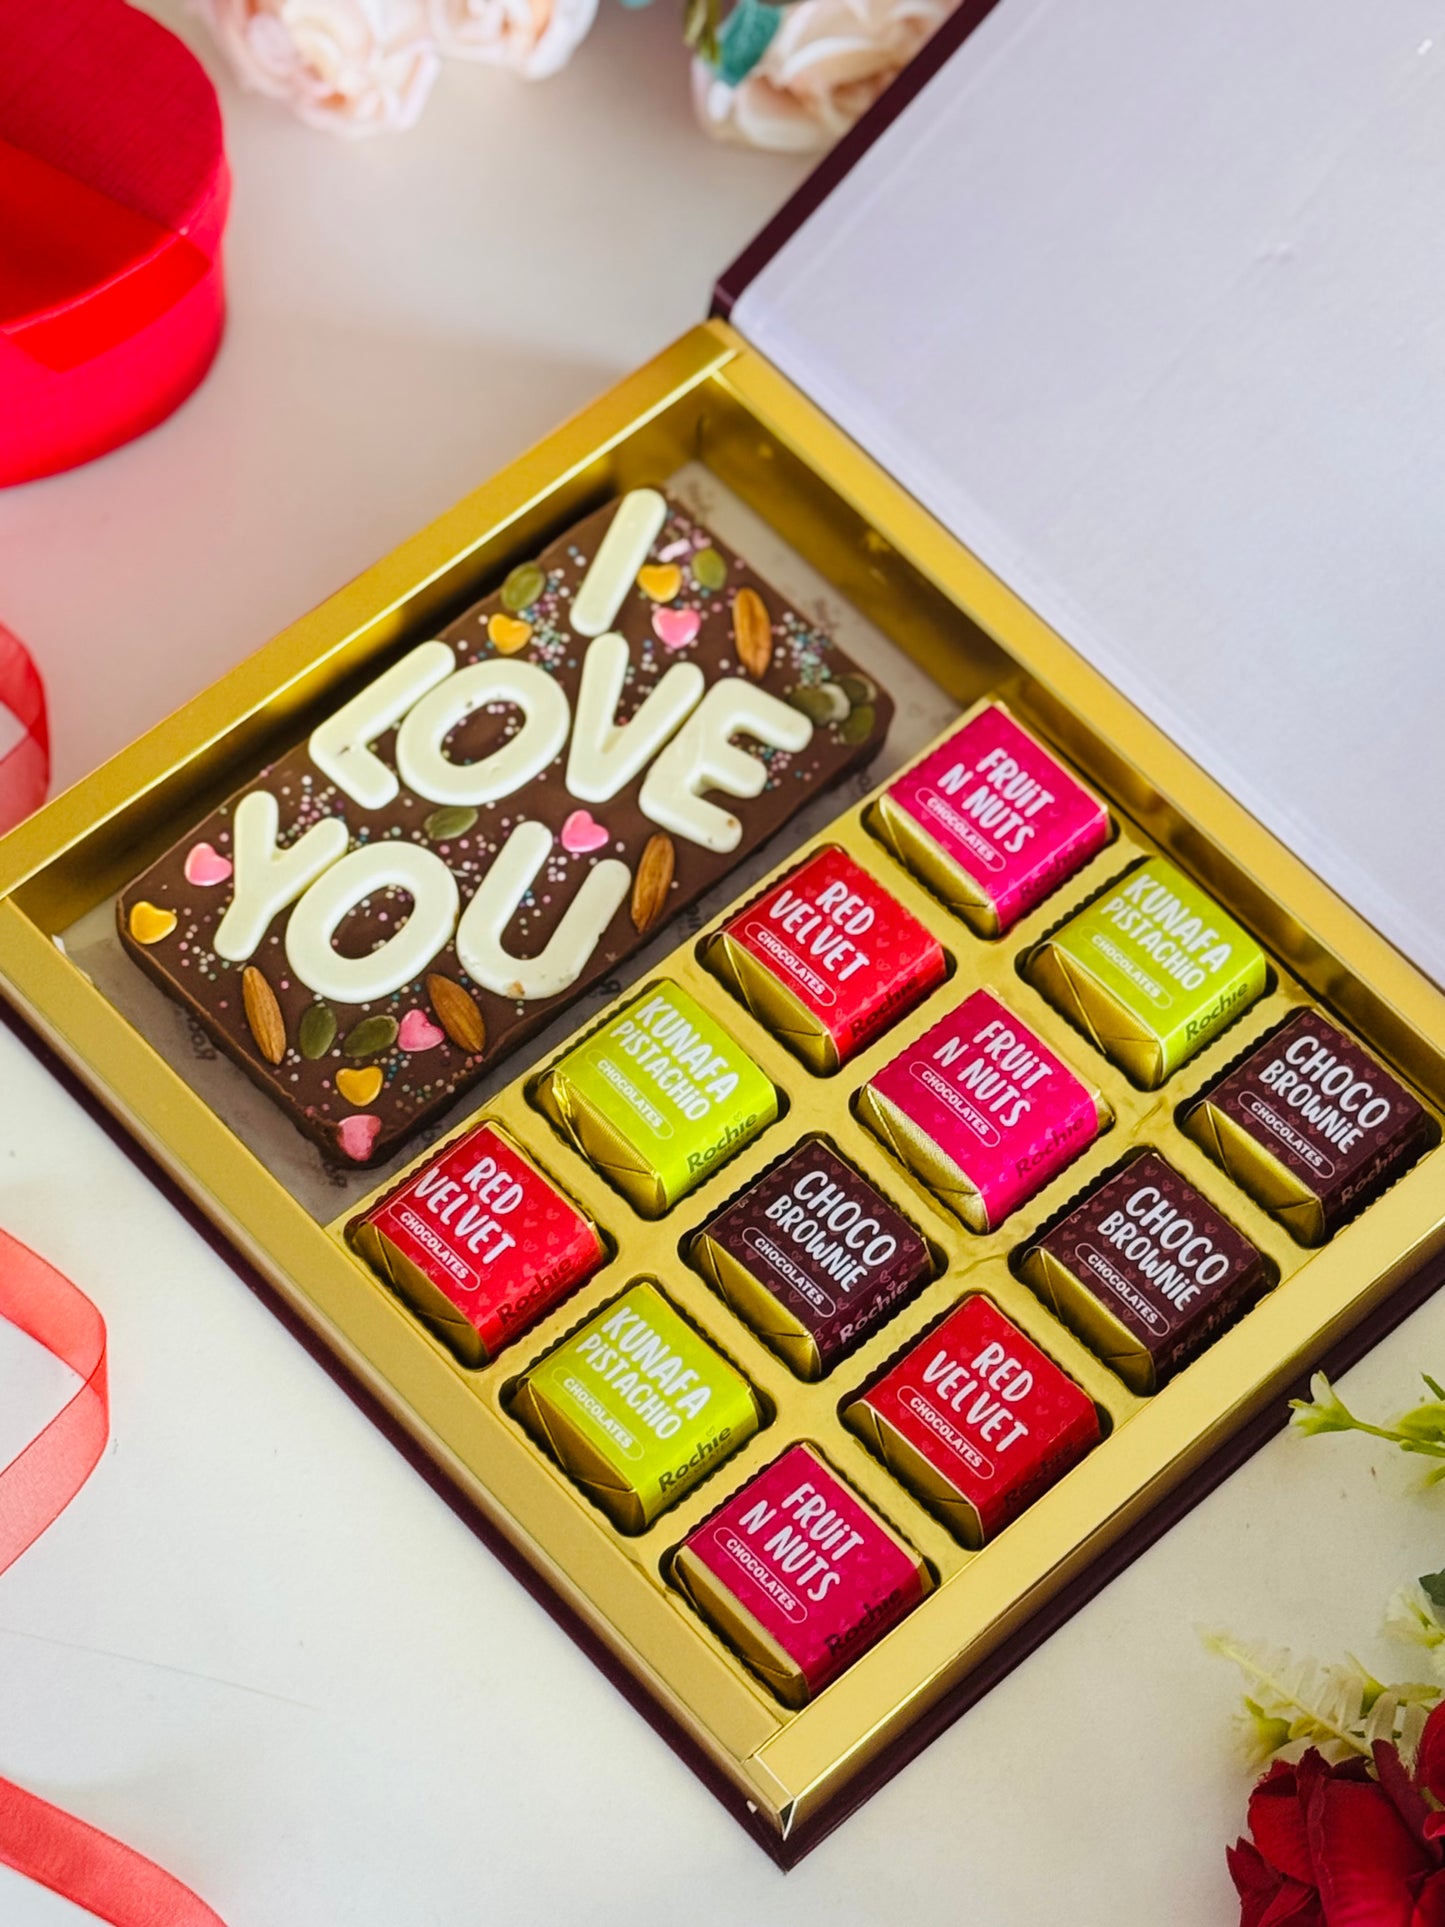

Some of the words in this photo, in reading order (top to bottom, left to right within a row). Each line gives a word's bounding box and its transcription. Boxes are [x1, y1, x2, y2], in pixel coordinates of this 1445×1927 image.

[570, 488, 667, 637] I
[308, 631, 814, 853] LOVE
[927, 797, 993, 861] CHOCOLATES
[937, 763, 973, 795] N
[962, 785, 1034, 853] NUTS
[213, 790, 632, 1004] YOU
[815, 881, 874, 935] RED
[1124, 874, 1231, 973] KUNAFA
[757, 931, 825, 995] CHOCOLATES
[769, 890, 870, 981] VELVET
[1092, 934, 1161, 998] CHOCOLATES
[851, 977, 918, 1038] Rochie
[1186, 980, 1249, 1041] Rochie
[635, 996, 739, 1103] KUNAFA
[933, 1036, 969, 1067] N
[957, 1058, 1030, 1127] NUTS
[1286, 1036, 1390, 1128] CHOCO
[598, 1059, 663, 1127] CHOCOLATES
[922, 1071, 989, 1135] CHOCOLATES
[686, 1112, 758, 1173] Rochie
[1015, 1117, 1085, 1178] Rochie
[1251, 1102, 1323, 1167] CHOCOLATES
[414, 1167, 516, 1264] VELVET
[462, 1156, 523, 1214] RED
[794, 1171, 896, 1266] CHOCO
[400, 1212, 468, 1279] CHOCOLATES
[1126, 1187, 1229, 1285] CHOCO
[497, 1257, 572, 1325] Rochie
[755, 1238, 824, 1305] CHOCOLATES
[1088, 1254, 1158, 1323] CHOCOLATES
[839, 1281, 908, 1343] Rochie
[601, 1307, 711, 1420] KUNAFA
[971, 1342, 1033, 1402] RED
[564, 1378, 632, 1449] CHOCOLATES
[910, 1397, 982, 1467] CHOCOLATES
[923, 1350, 1029, 1452] VELVET
[658, 1426, 731, 1493] Rochie
[726, 1538, 796, 1611] CHOCOLATES
[739, 1500, 777, 1534] N
[764, 1525, 840, 1601] NUTS
